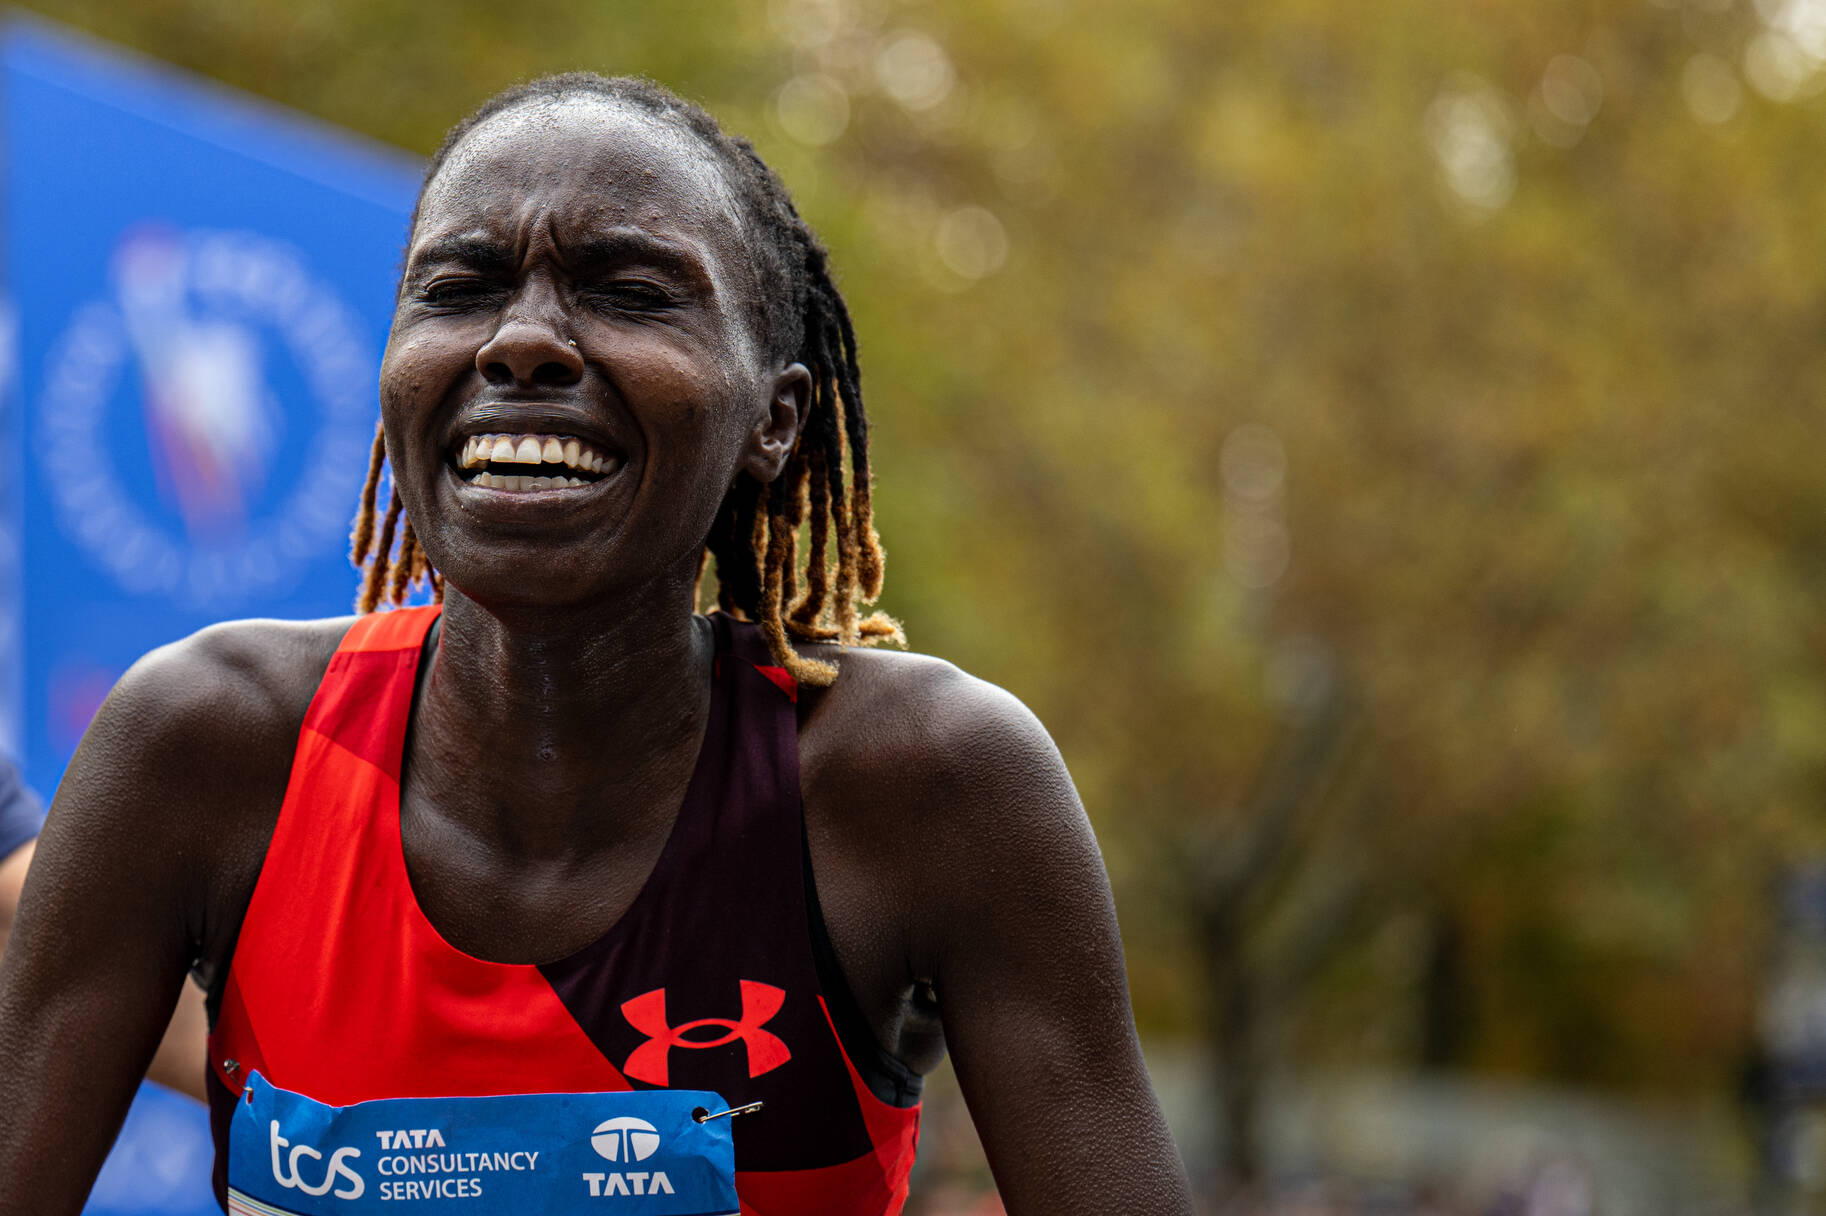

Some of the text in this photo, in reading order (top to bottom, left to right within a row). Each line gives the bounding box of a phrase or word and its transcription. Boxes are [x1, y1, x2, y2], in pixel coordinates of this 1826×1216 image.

[376, 1130, 445, 1149] TATA
[271, 1120, 364, 1199] tcs
[378, 1152, 538, 1175] CONSULTANCY
[380, 1179, 482, 1200] SERVICES
[583, 1172, 674, 1196] TATA
